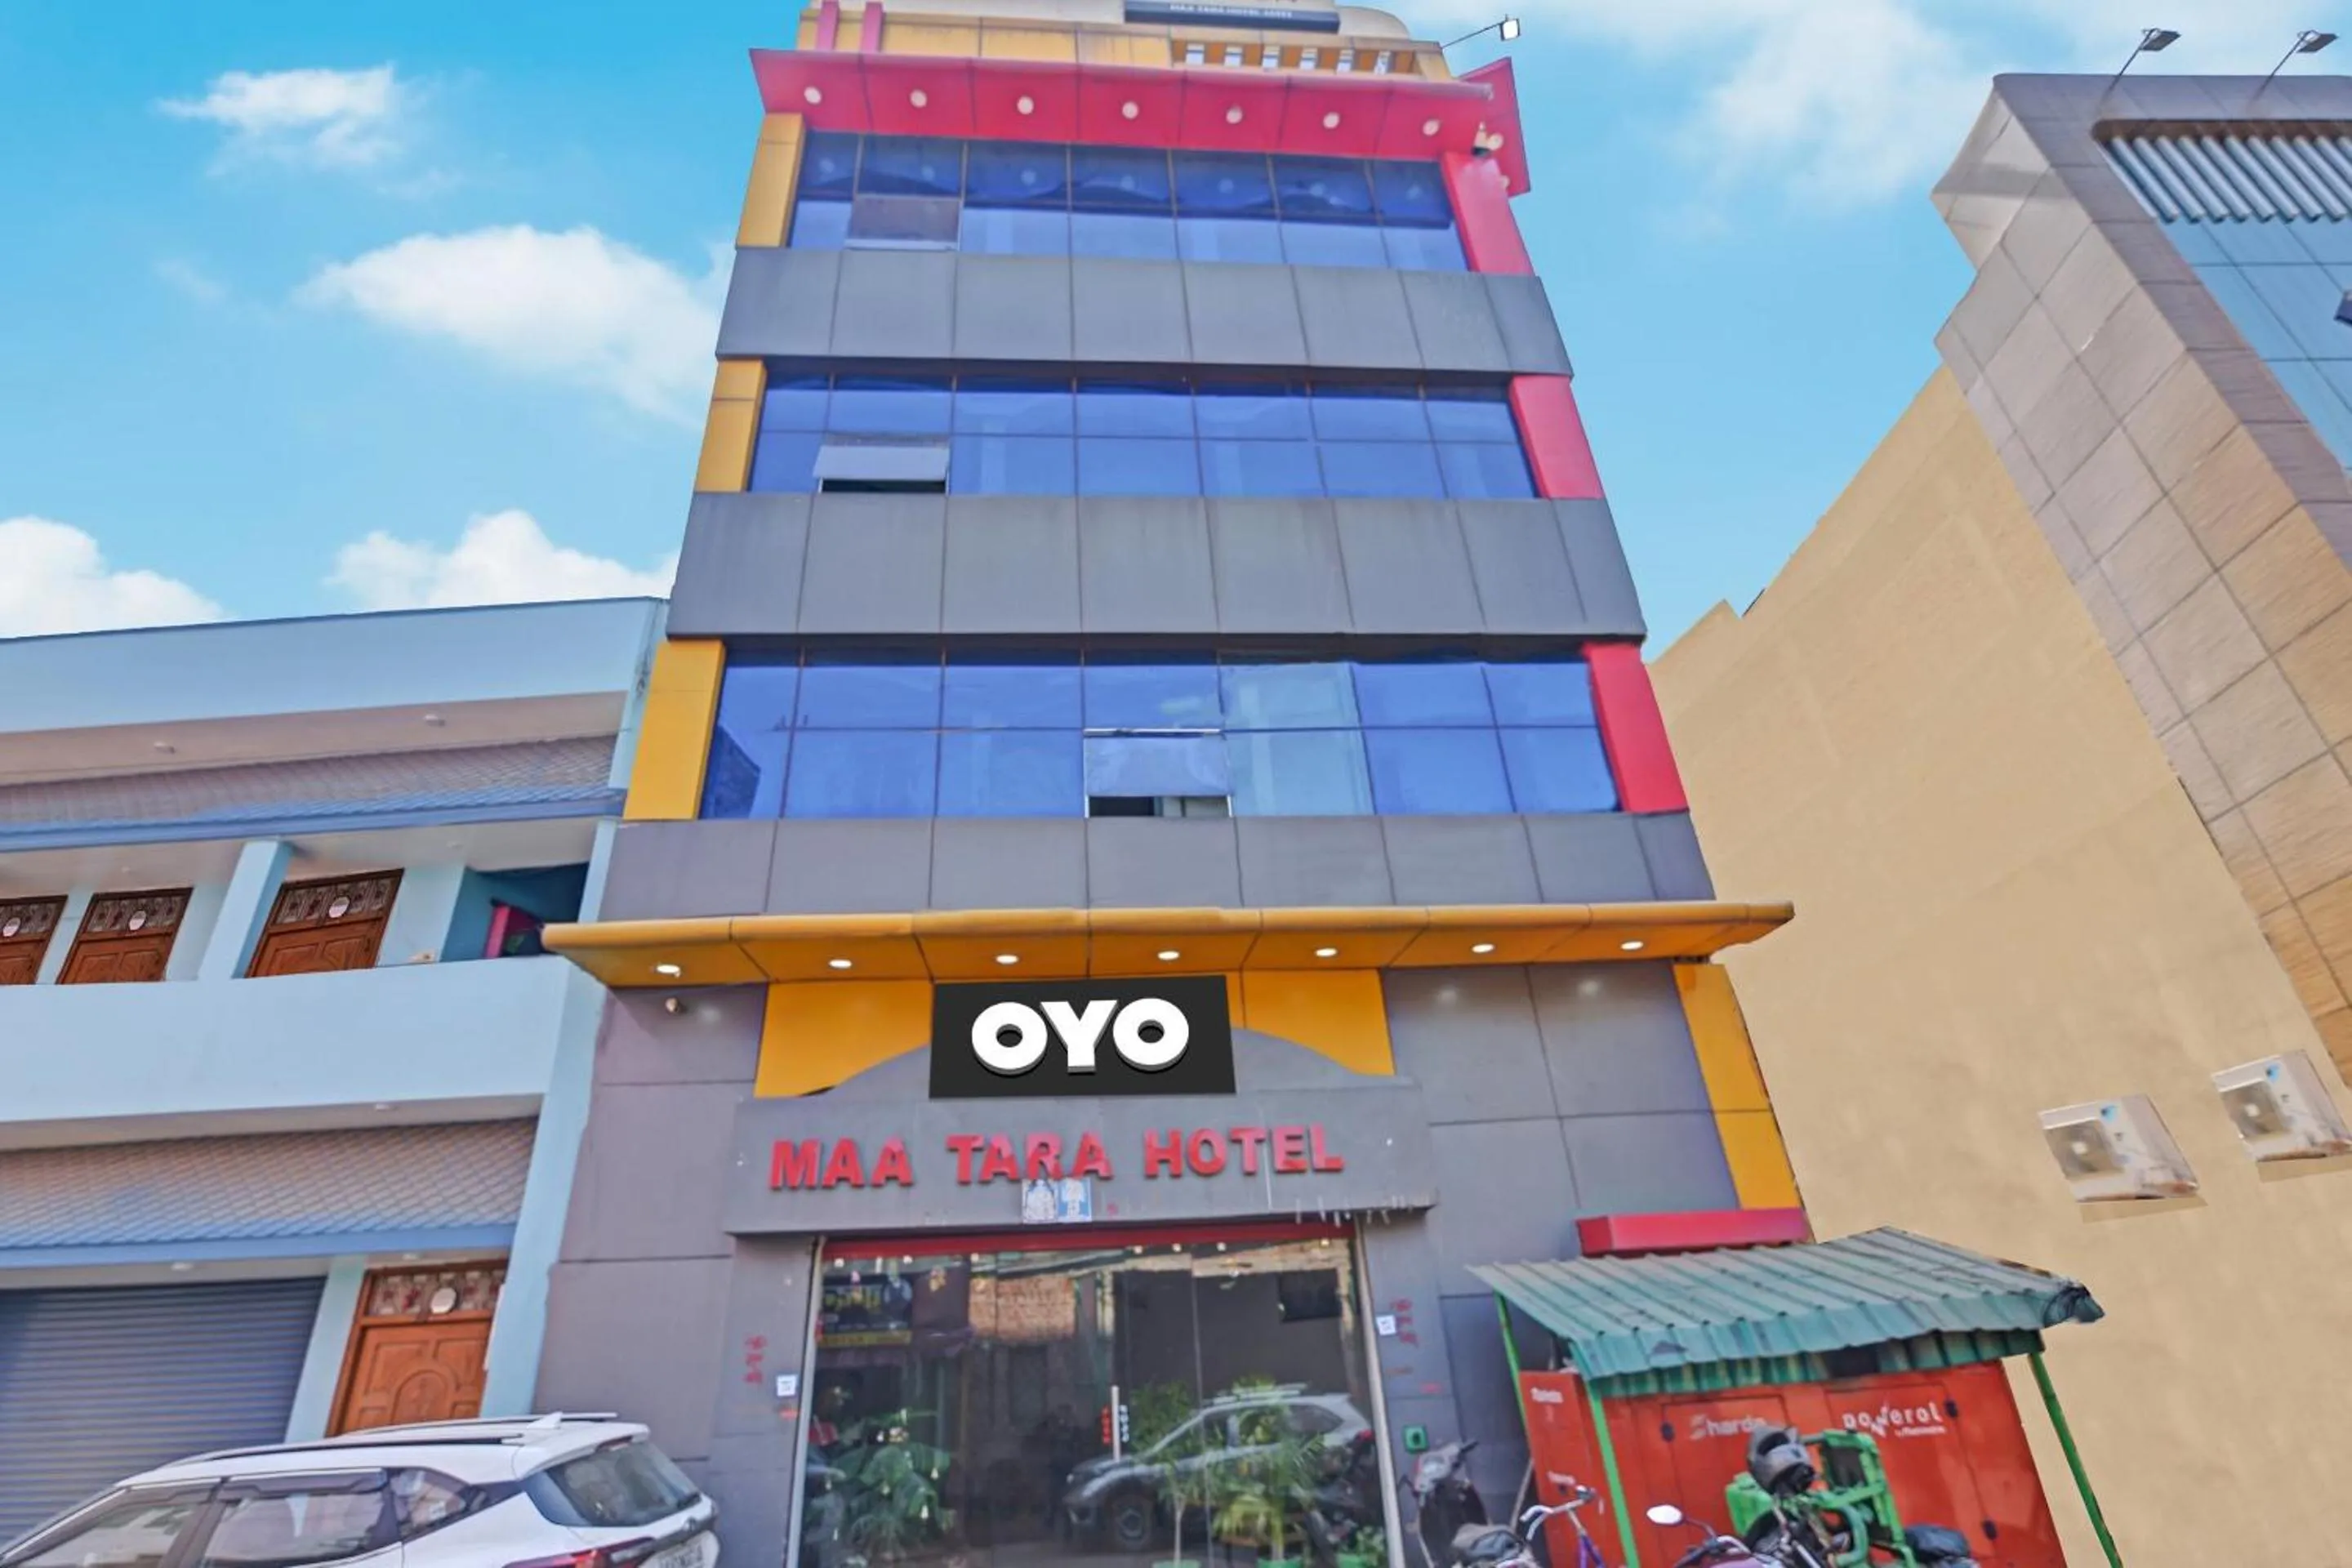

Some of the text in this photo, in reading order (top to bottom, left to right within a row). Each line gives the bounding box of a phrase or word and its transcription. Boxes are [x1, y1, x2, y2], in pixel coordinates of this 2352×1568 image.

[971, 997, 1189, 1076] OYO
[770, 1122, 1344, 1191] MAA TARA HOTEL
